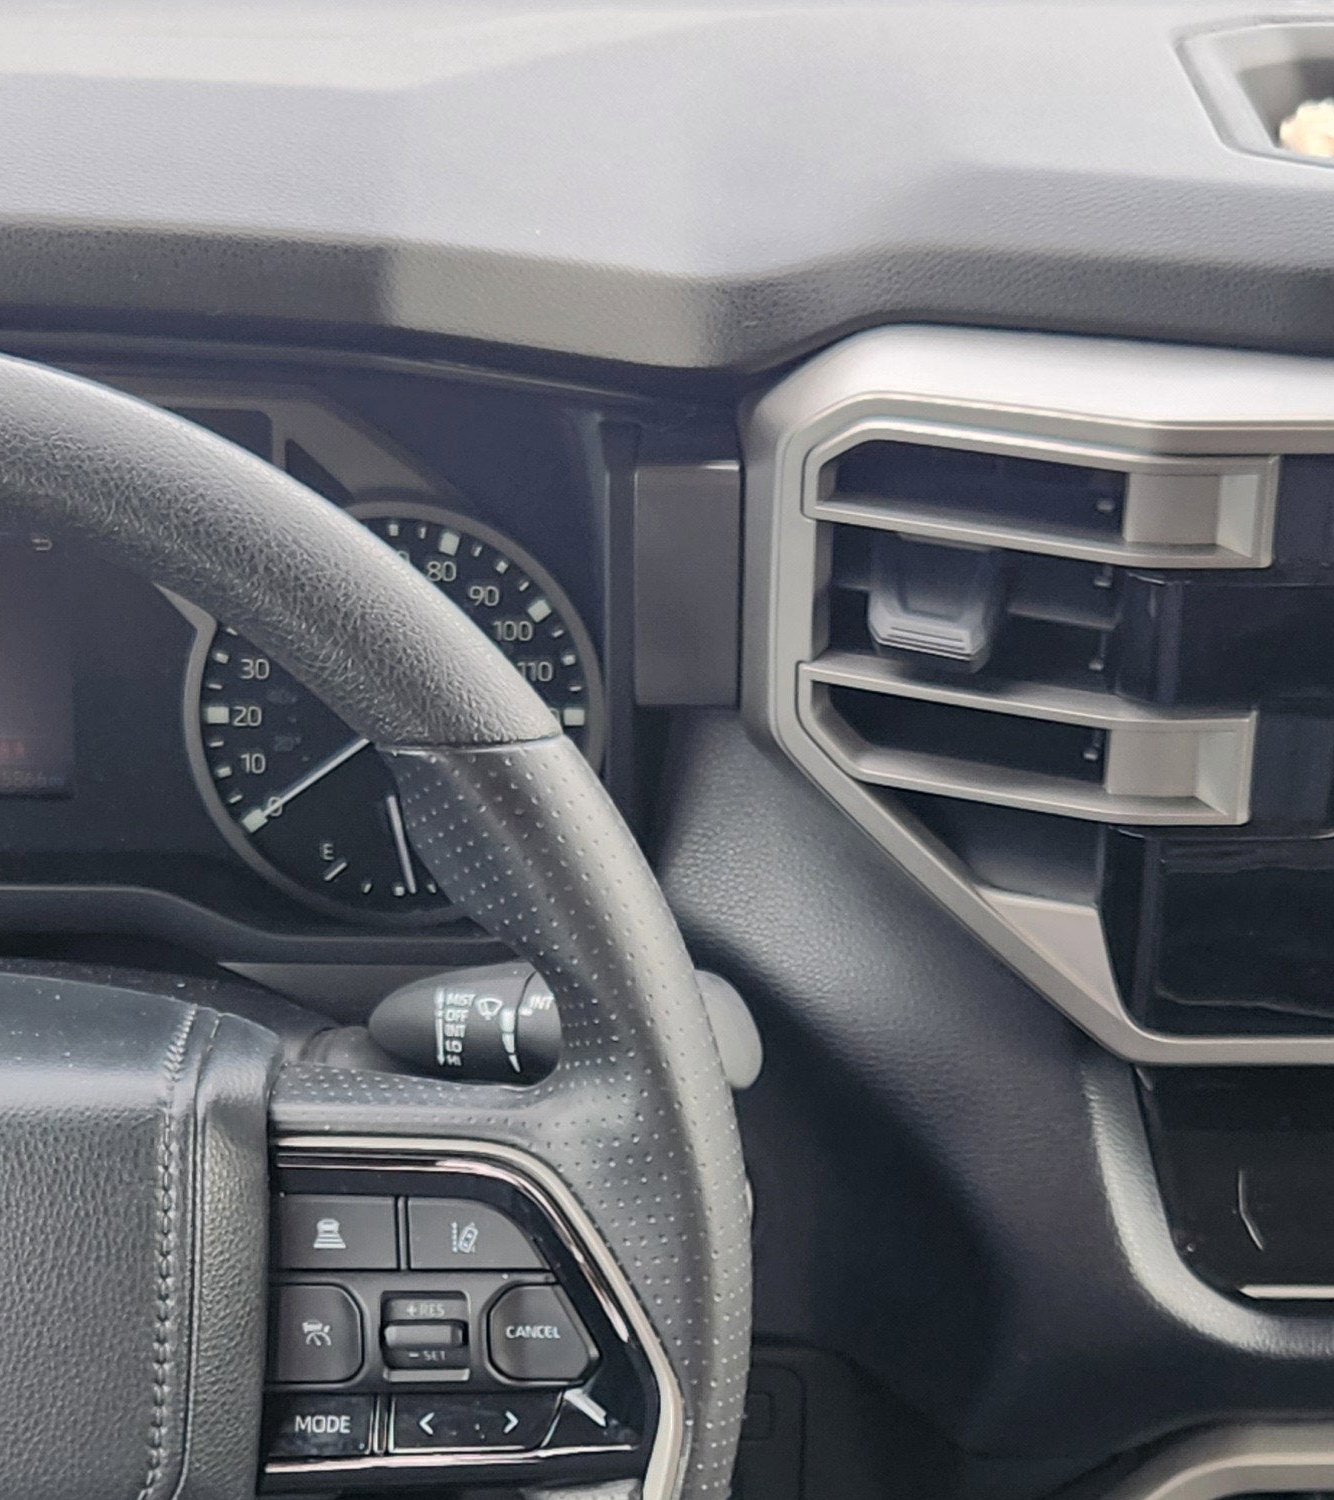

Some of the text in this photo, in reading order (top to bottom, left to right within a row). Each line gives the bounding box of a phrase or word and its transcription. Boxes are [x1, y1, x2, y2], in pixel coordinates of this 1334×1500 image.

[426, 561, 457, 582] 80
[469, 586, 501, 607] 90
[492, 620, 534, 642] 100
[240, 658, 270, 681] 30
[517, 660, 554, 682] 110
[233, 706, 263, 728] 20
[240, 752, 266, 774] 10
[320, 842, 334, 861] E
[528, 995, 555, 1010] INT
[445, 1009, 469, 1023] OFF
[505, 1325, 561, 1340] CANCEL
[294, 1414, 351, 1435] MODE
